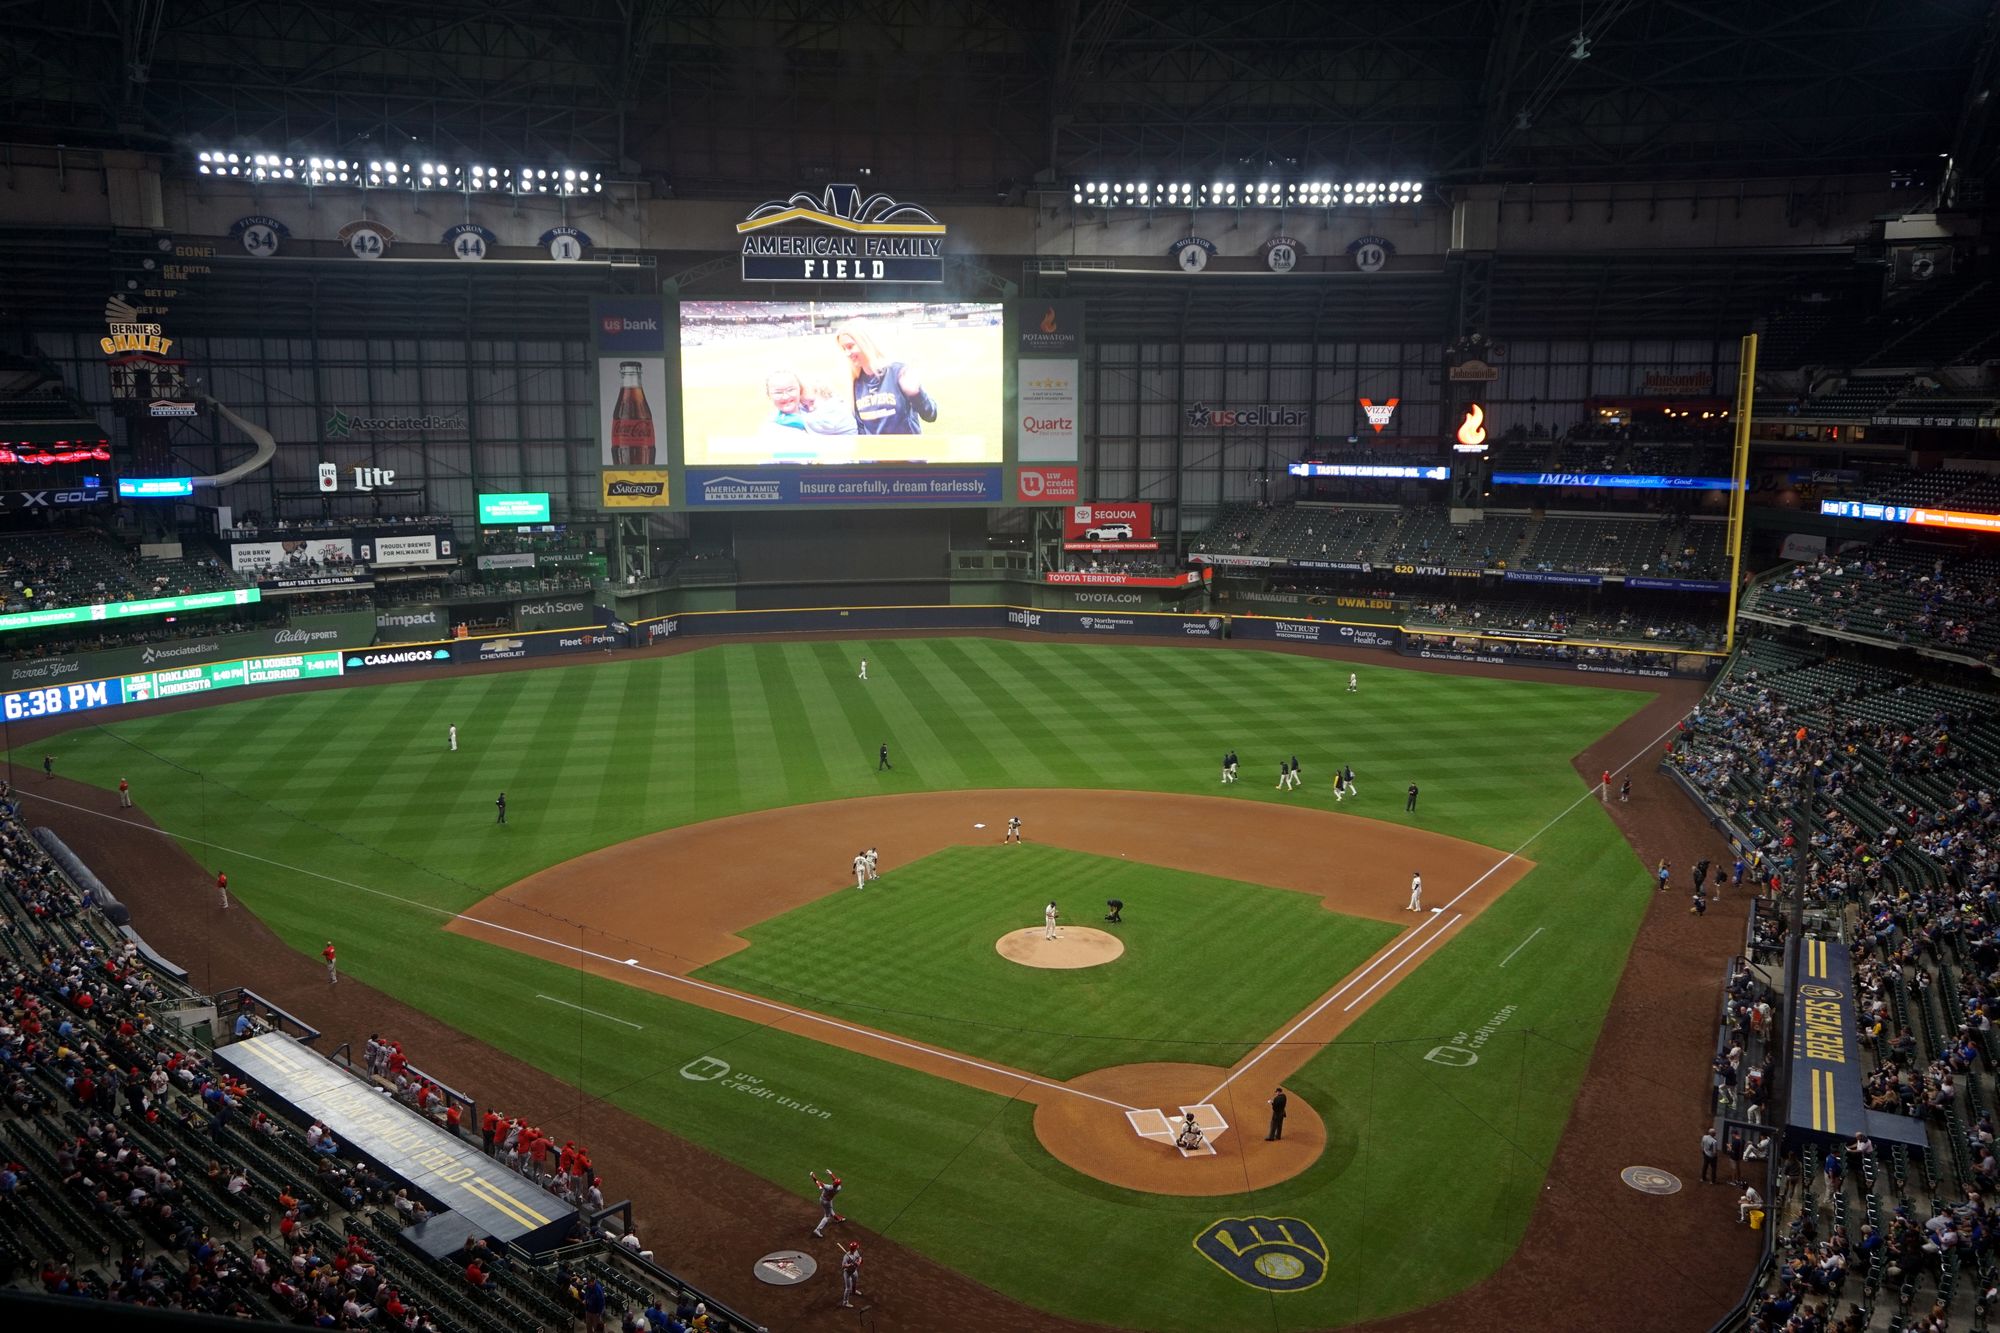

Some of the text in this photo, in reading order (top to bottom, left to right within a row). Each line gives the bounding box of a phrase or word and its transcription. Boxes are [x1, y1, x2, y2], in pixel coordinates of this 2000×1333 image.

[240, 216, 279, 229] FINGERS
[455, 224, 483, 235] AARON
[552, 228, 577, 237] SELIG
[248, 232, 273, 248] 34
[355, 236, 379, 251] 42
[742, 236, 944, 257] AMERICAN FAMILY
[1176, 237, 1209, 249] MOLITOR
[1267, 239, 1297, 248] UECKER
[1358, 237, 1384, 245] YOUNT
[176, 246, 216, 257] GONE!
[458, 242, 482, 255] 44
[562, 242, 572, 258] 1
[1273, 249, 1290, 261] 50
[1186, 251, 1197, 266] 4
[1361, 250, 1381, 266] 19
[804, 259, 885, 279] FIELD
[144, 289, 177, 298] GET UP
[156, 307, 169, 315] UP
[110, 323, 161, 335] BERNIE'S
[624, 317, 657, 331] bank
[100, 335, 173, 355] CHALET
[1451, 368, 1497, 379] Johnsonville
[1644, 371, 1712, 386] Johnsonville
[1365, 407, 1394, 415] VIZZY
[1023, 416, 1072, 433] Quartz
[1317, 466, 1339, 475] TASTE
[1340, 466, 1357, 475] YOU
[354, 467, 395, 490] Lite
[1046, 479, 1074, 487] credit
[1538, 473, 1600, 486] IMPACT
[612, 484, 657, 494] SARGENTO
[705, 485, 779, 494] AMERICAN FAMILY
[800, 480, 986, 495] Insure carefully, dream fearlessly.
[20, 491, 109, 507] X GOLF
[1094, 510, 1136, 519] SEQUOIA
[1394, 565, 1414, 574] 620
[1416, 566, 1446, 576] WTMJ
[1507, 572, 1543, 581] WINTRUST
[1049, 574, 1127, 583] TOYOTA TERRITORY
[1075, 592, 1142, 604] TOYOTA.COM
[1337, 598, 1392, 609] UWM.EDU
[521, 604, 544, 615] Pick
[556, 602, 584, 612] Save
[385, 612, 436, 627] impact
[1008, 610, 1041, 627] meijer
[1094, 617, 1134, 625] Northwestern
[649, 619, 678, 636] meijer
[1276, 622, 1320, 633] WINTRUST
[1354, 630, 1376, 638] Aurora
[275, 630, 337, 644] Bally SPORTS
[560, 637, 582, 647] Fleet
[1354, 637, 1392, 646] Health Care
[365, 651, 433, 665] CASAMIGOS
[480, 651, 525, 660] CHEVROLET
[250, 656, 304, 669] LA DODGERS
[325, 659, 339, 669] PM
[12, 661, 79, 680] Barrel Yard
[159, 668, 202, 683] OAKLAND
[250, 668, 299, 682] COLORADO
[160, 679, 211, 696] MINNESOTA
[5, 681, 107, 719] 6:38 PM
[1468, 1004, 1518, 1048] credit union
[1805, 999, 1845, 1064] BREWERS
[1451, 1032, 1469, 1044] uw
[735, 1072, 764, 1084] uw
[720, 1079, 832, 1119] credit union
[412, 1148, 476, 1183] FIELD
